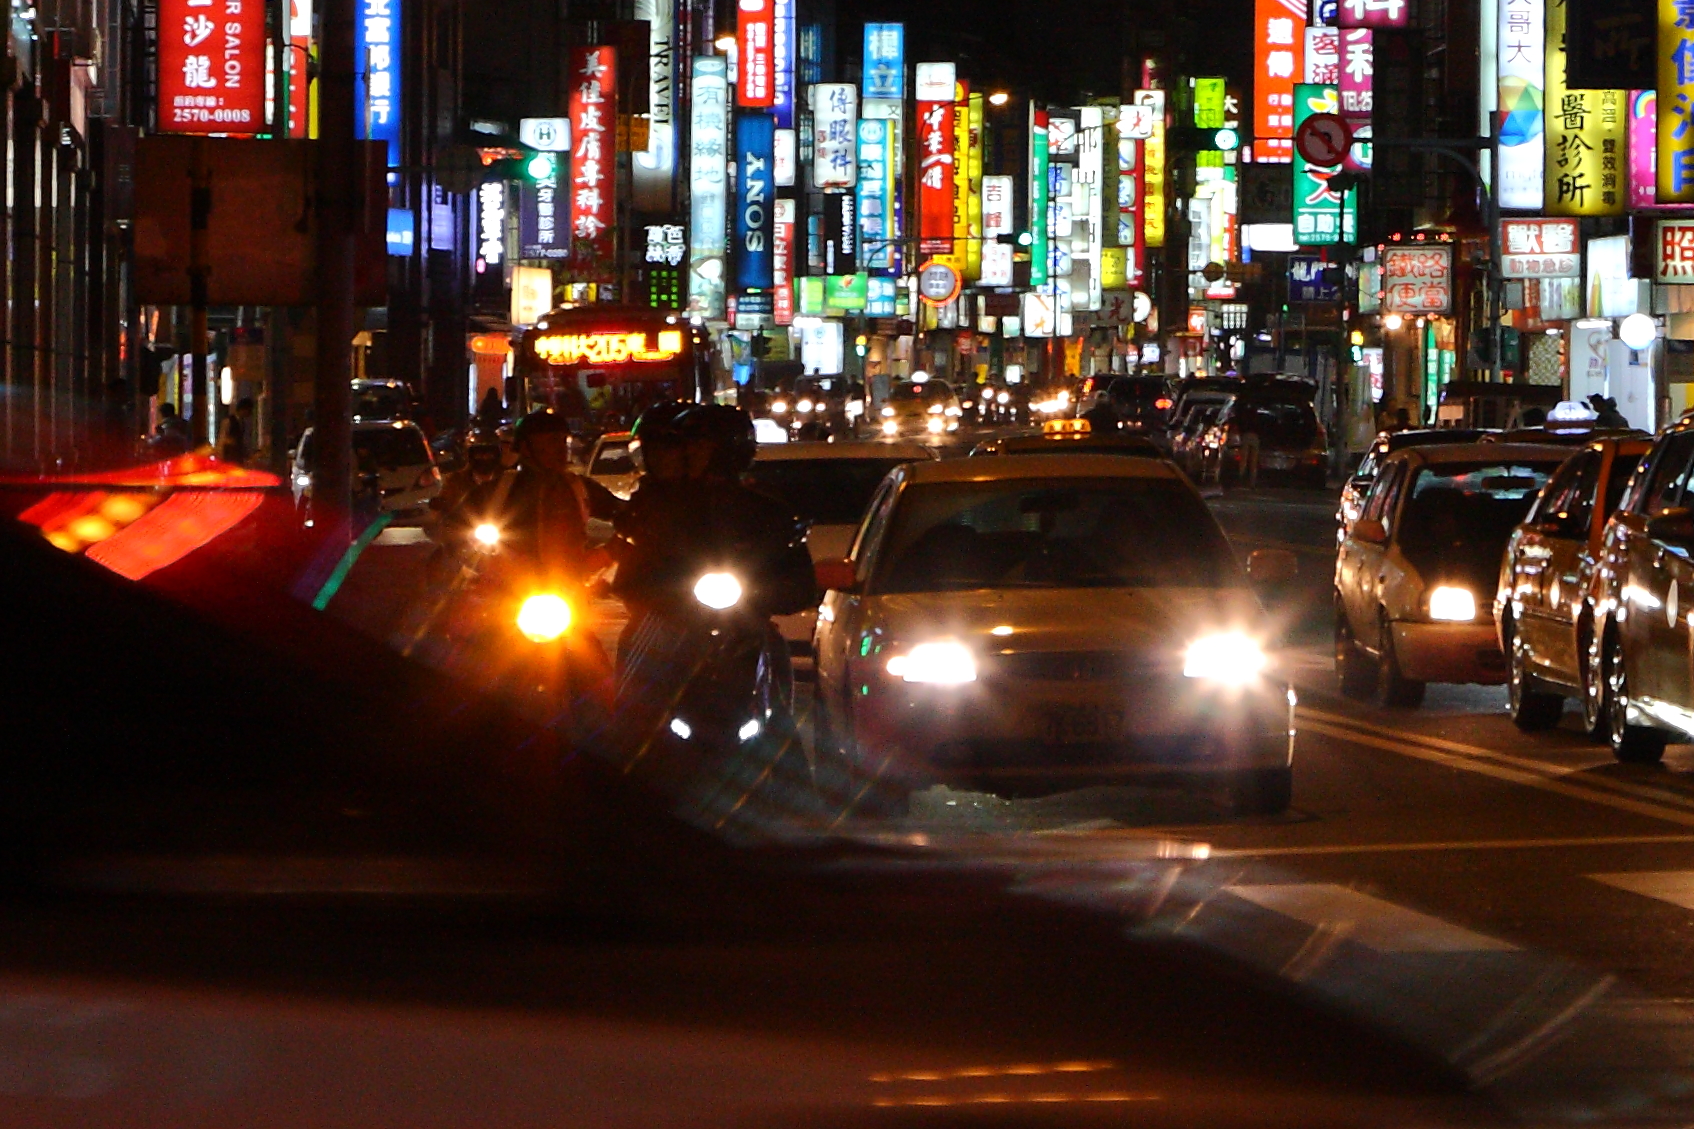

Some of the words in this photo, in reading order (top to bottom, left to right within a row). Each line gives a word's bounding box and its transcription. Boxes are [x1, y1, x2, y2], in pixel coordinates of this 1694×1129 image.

[225, 23, 242, 89] SALON
[173, 108, 251, 123] 2570-0008
[745, 151, 765, 253] SONY
[1506, 223, 1575, 254] 獸醫
